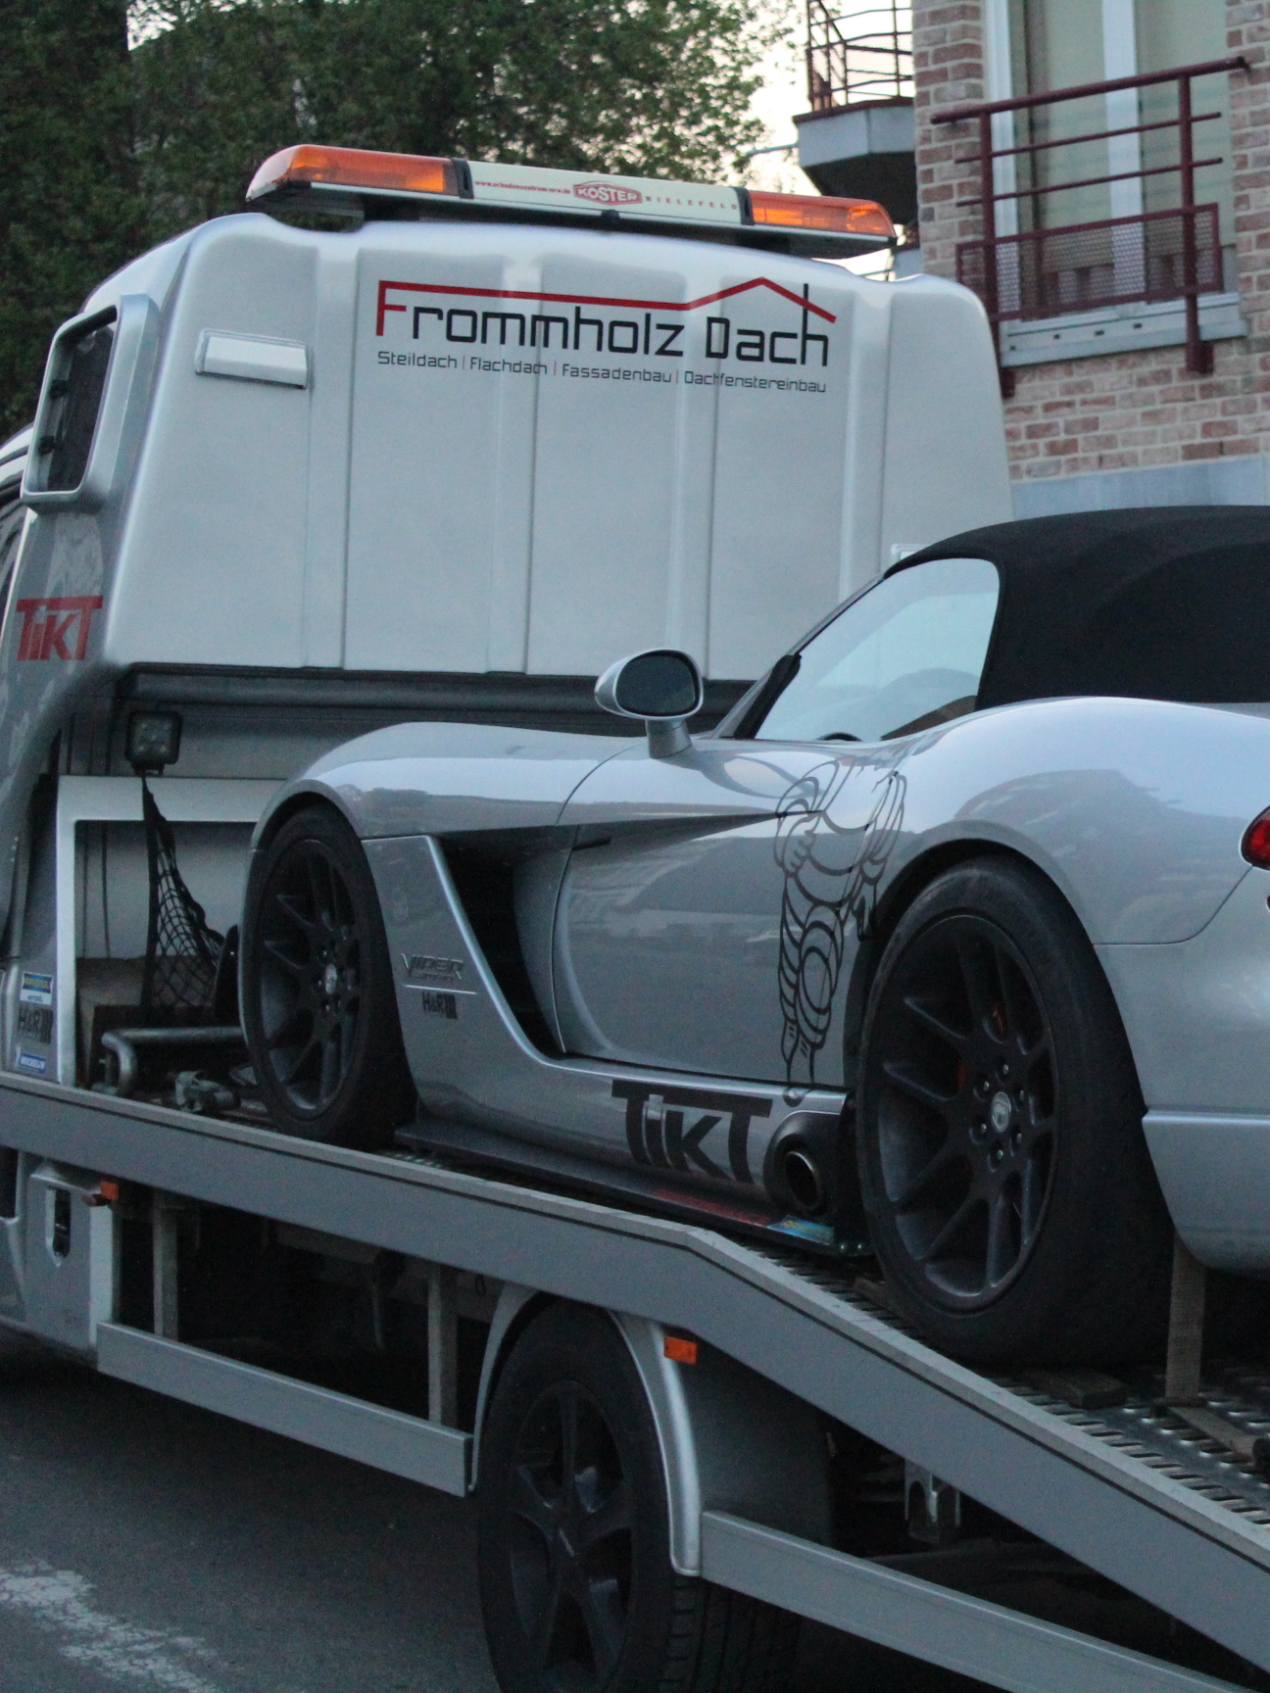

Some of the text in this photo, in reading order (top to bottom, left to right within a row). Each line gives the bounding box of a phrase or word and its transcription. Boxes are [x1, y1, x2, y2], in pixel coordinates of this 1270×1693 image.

[645, 196, 738, 210] BIELEFELD
[376, 280, 829, 367] Frommholz Dach
[378, 351, 826, 393] Steildach Flachdach Fassadenbau Dachfenstereinbau
